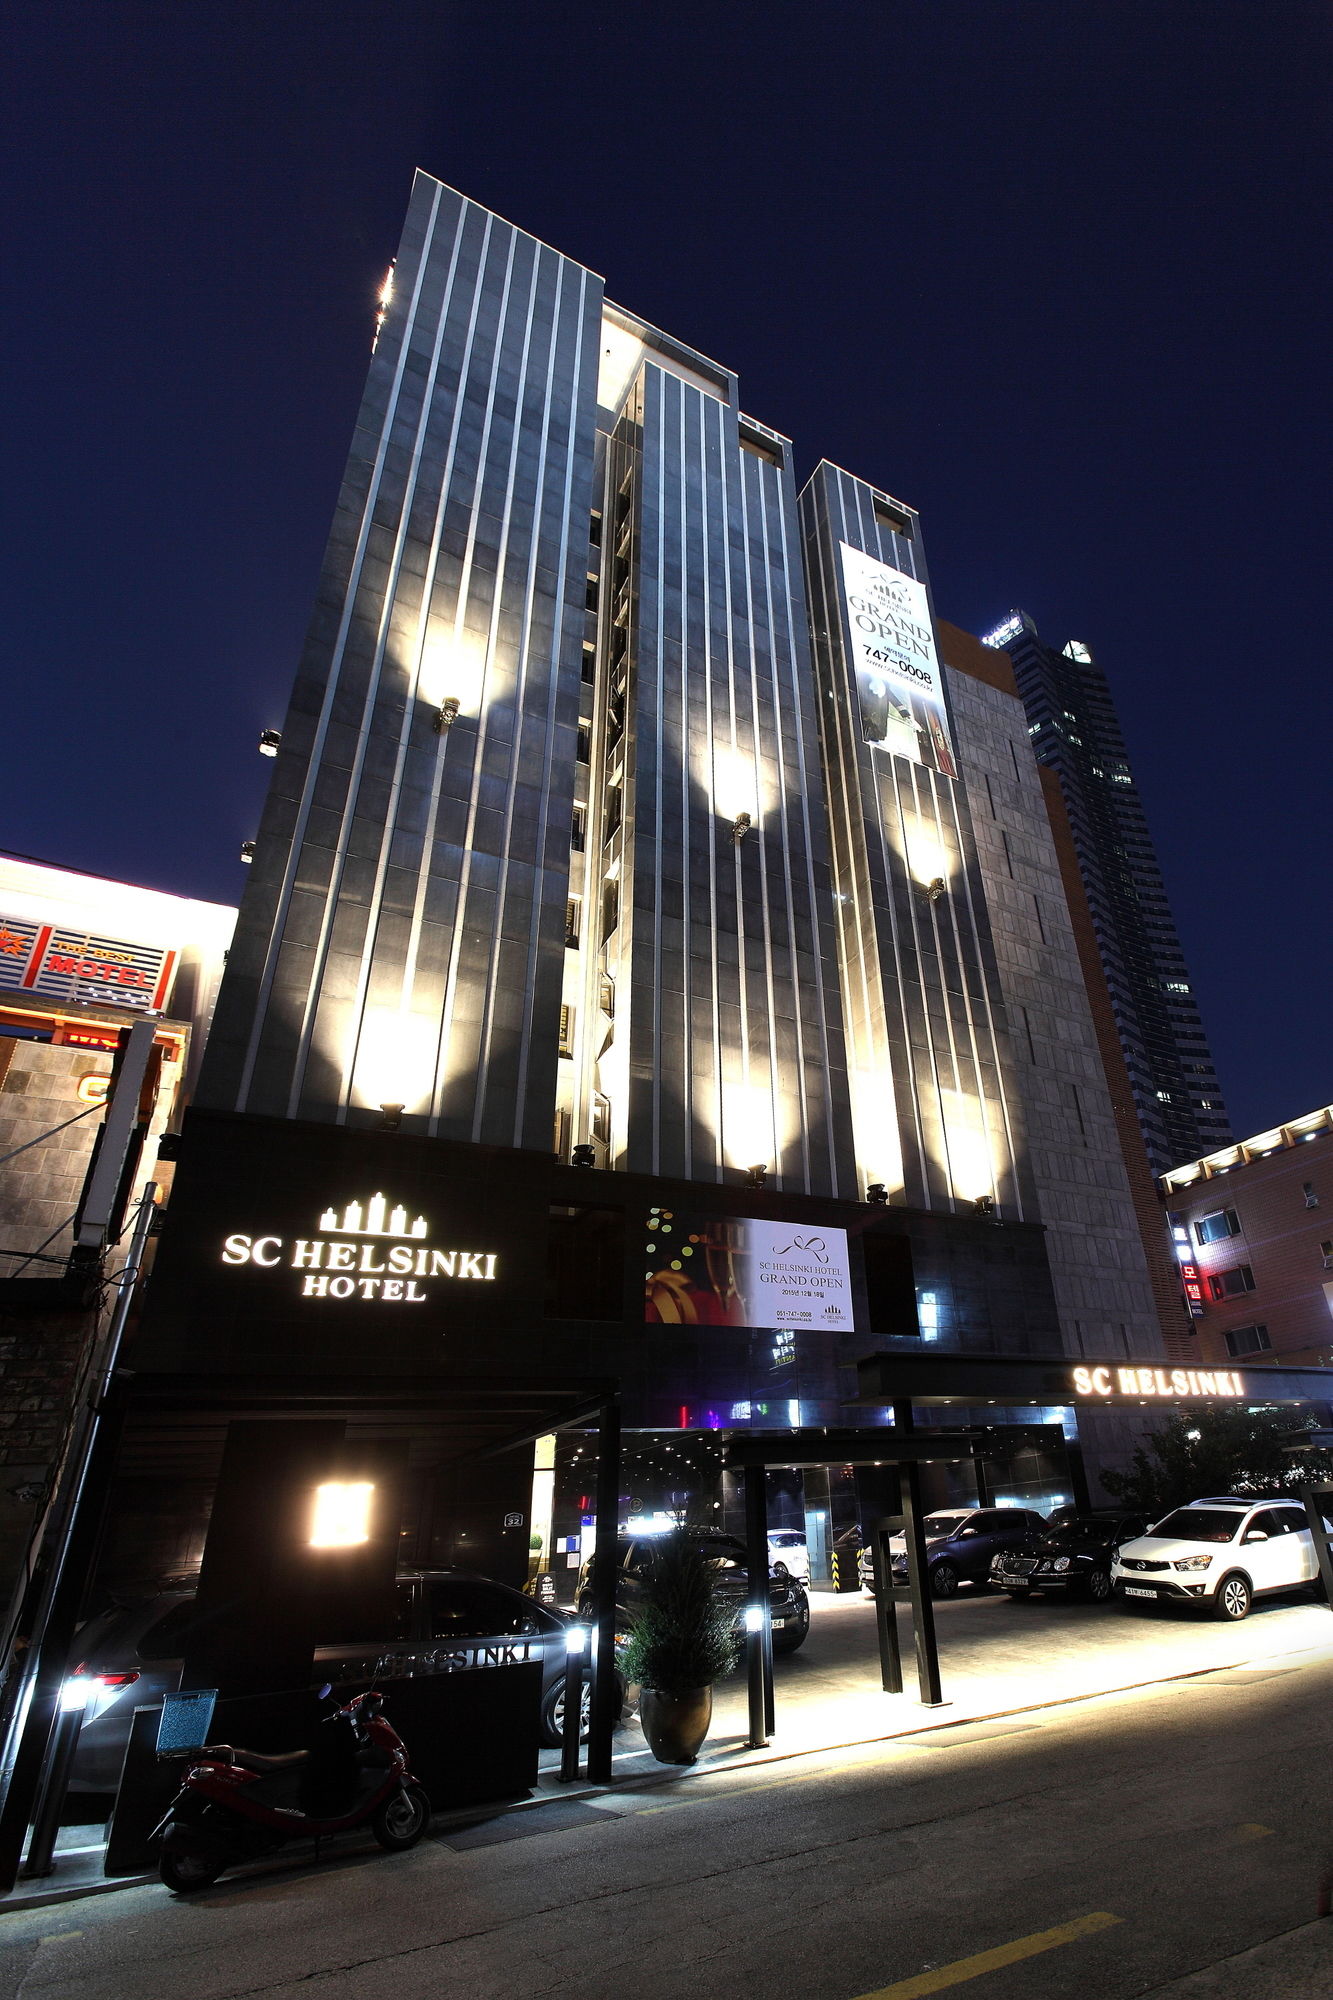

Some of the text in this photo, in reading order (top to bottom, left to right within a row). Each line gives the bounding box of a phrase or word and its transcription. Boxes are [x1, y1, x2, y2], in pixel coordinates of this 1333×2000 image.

[849, 595, 932, 643] GRAND
[855, 614, 931, 661] OPEN
[862, 644, 933, 685] 747-0008
[55, 941, 136, 964] THE BEST
[46, 955, 155, 989] MOTEL
[221, 1234, 498, 1280] SC HELSINKI
[759, 1262, 843, 1276] SC HELSINKI HOTEL
[302, 1275, 427, 1302] HOTEL
[760, 1273, 844, 1289] GRAND OPEN
[1073, 1366, 1246, 1396] SC HELSINKI
[507, 1518, 520, 1526] 32
